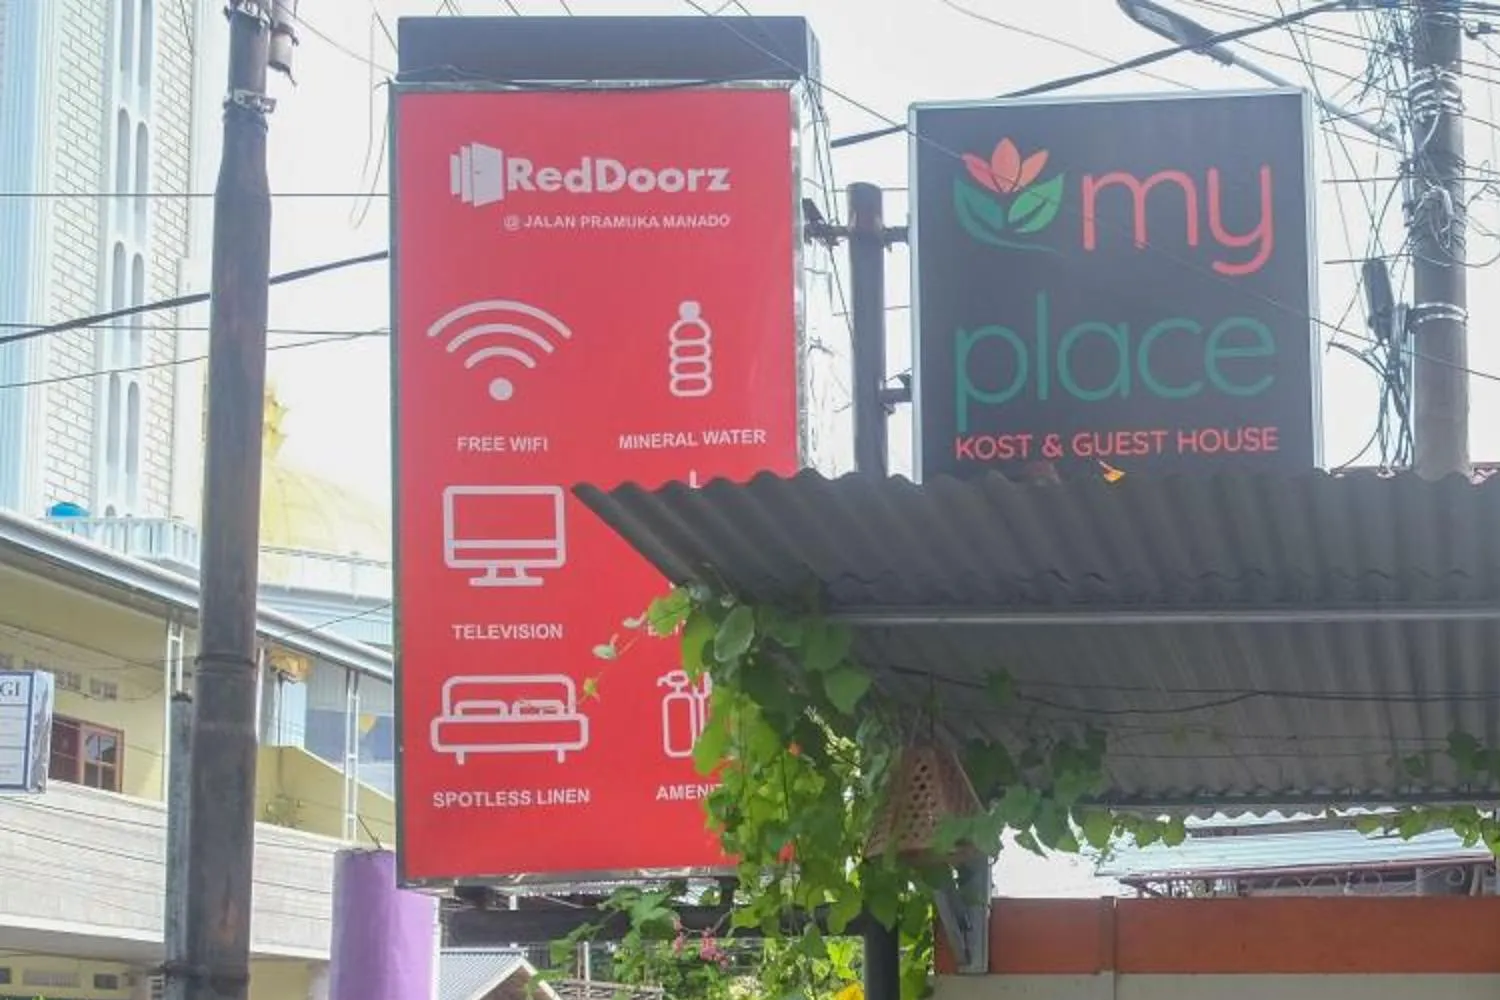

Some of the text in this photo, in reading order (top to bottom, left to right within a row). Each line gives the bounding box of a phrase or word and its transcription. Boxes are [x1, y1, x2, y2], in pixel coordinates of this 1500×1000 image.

[507, 156, 731, 193] RedDoorz
[524, 215, 576, 229] JALAN
[580, 215, 661, 229] PRAMUKA
[662, 213, 731, 229] MANADO
[1083, 163, 1274, 276] my
[955, 290, 1276, 433] place
[457, 436, 549, 453] FREE WIFI
[618, 429, 767, 449] MINERAL WATER
[955, 427, 1279, 460] KOST & GUEST HOUSE
[452, 623, 563, 640] TELEVISION
[432, 788, 591, 808] SPOTLESS LINEN
